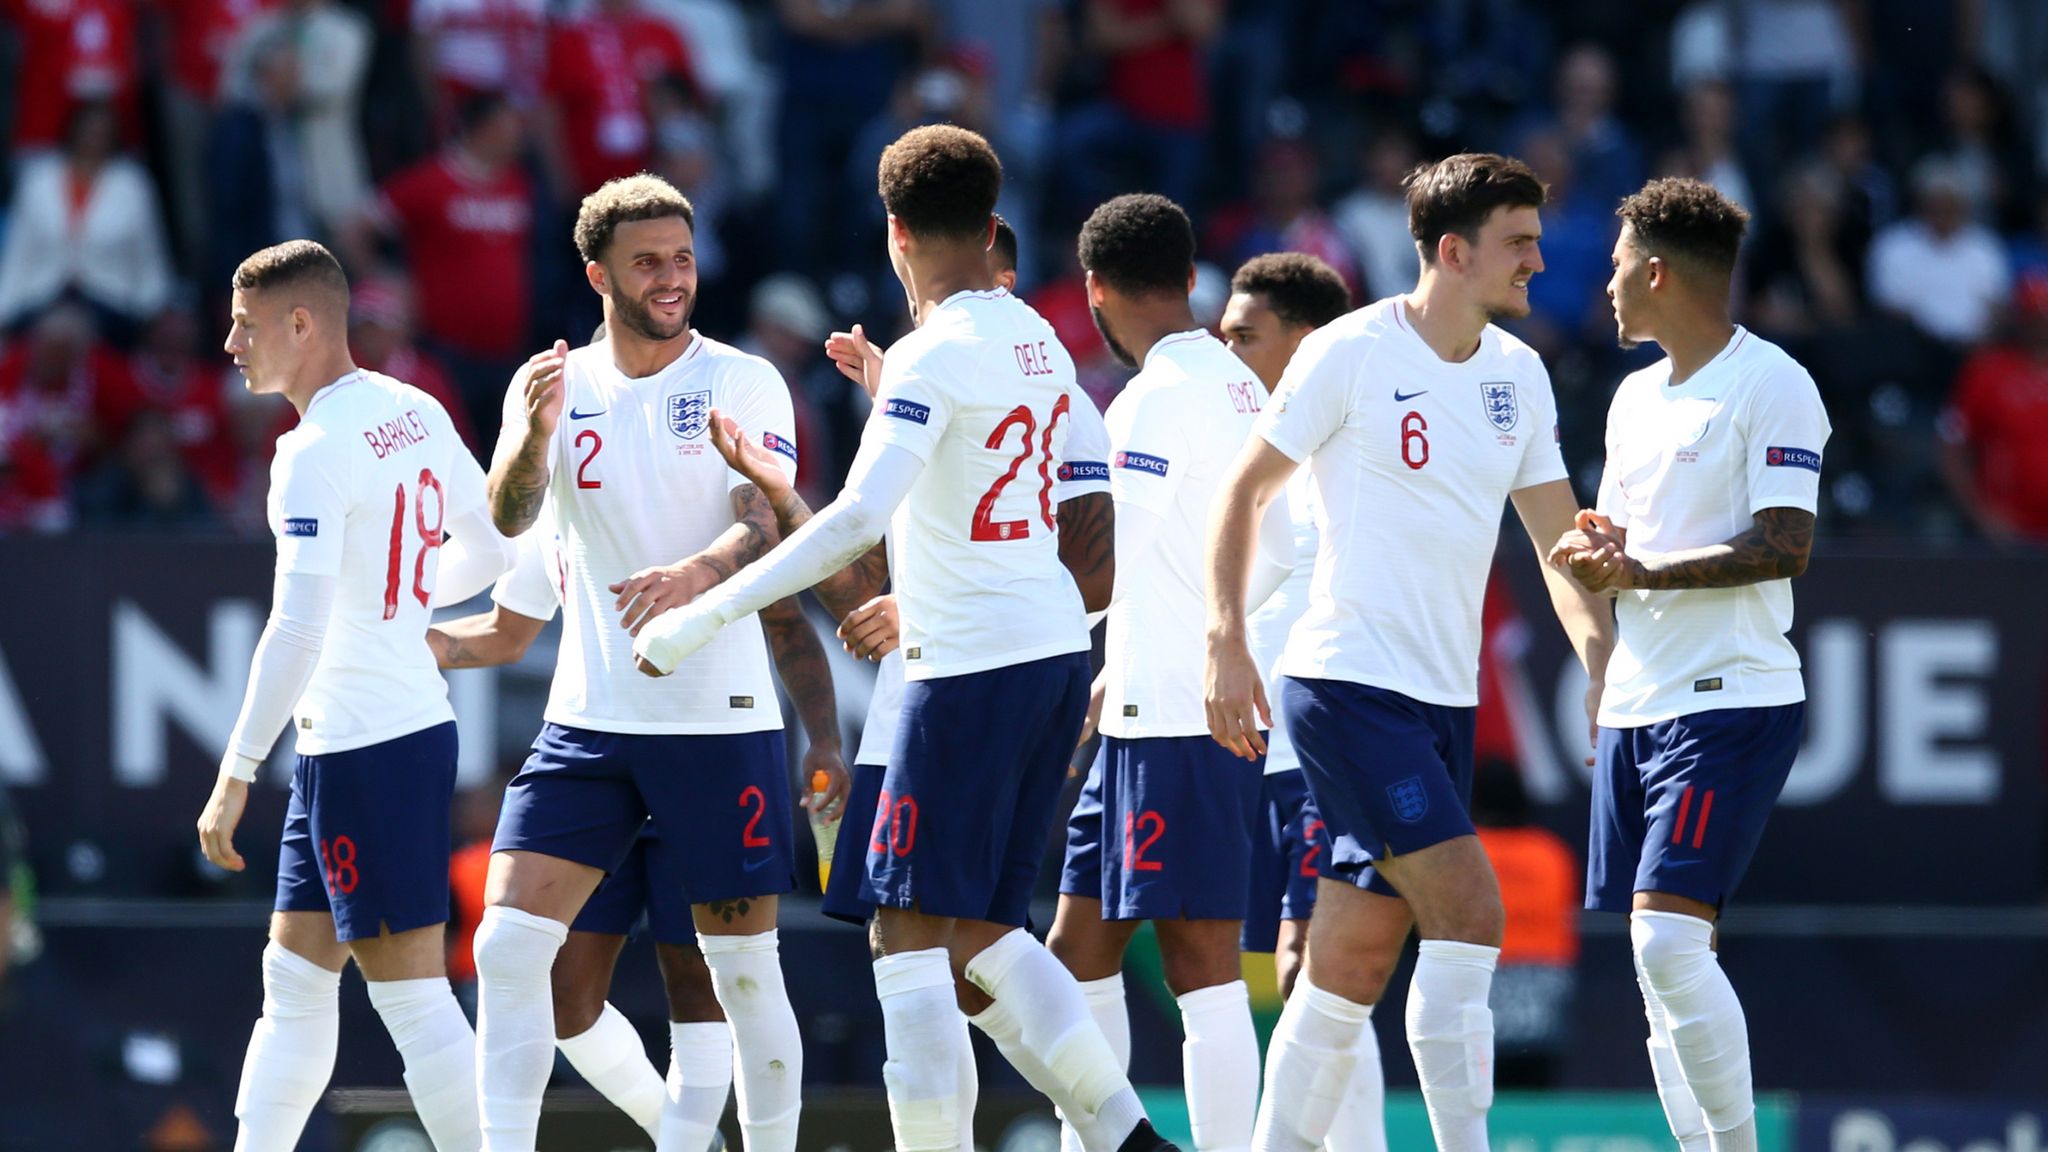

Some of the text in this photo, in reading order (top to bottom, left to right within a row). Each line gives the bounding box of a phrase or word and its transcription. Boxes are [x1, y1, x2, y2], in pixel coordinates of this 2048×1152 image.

[1014, 341, 1053, 376] DELE
[886, 402, 929, 421] RESPECT
[1401, 411, 1429, 470] 6
[575, 429, 602, 489] 2
[1127, 456, 1169, 473] RESPECT
[1784, 452, 1820, 469] RESPECT
[382, 467, 444, 621] 18
[739, 785, 770, 848] 2
[871, 789, 918, 857] 20
[1125, 809, 1167, 872] 12
[1672, 786, 1714, 848] 11
[321, 833, 359, 896] 18
